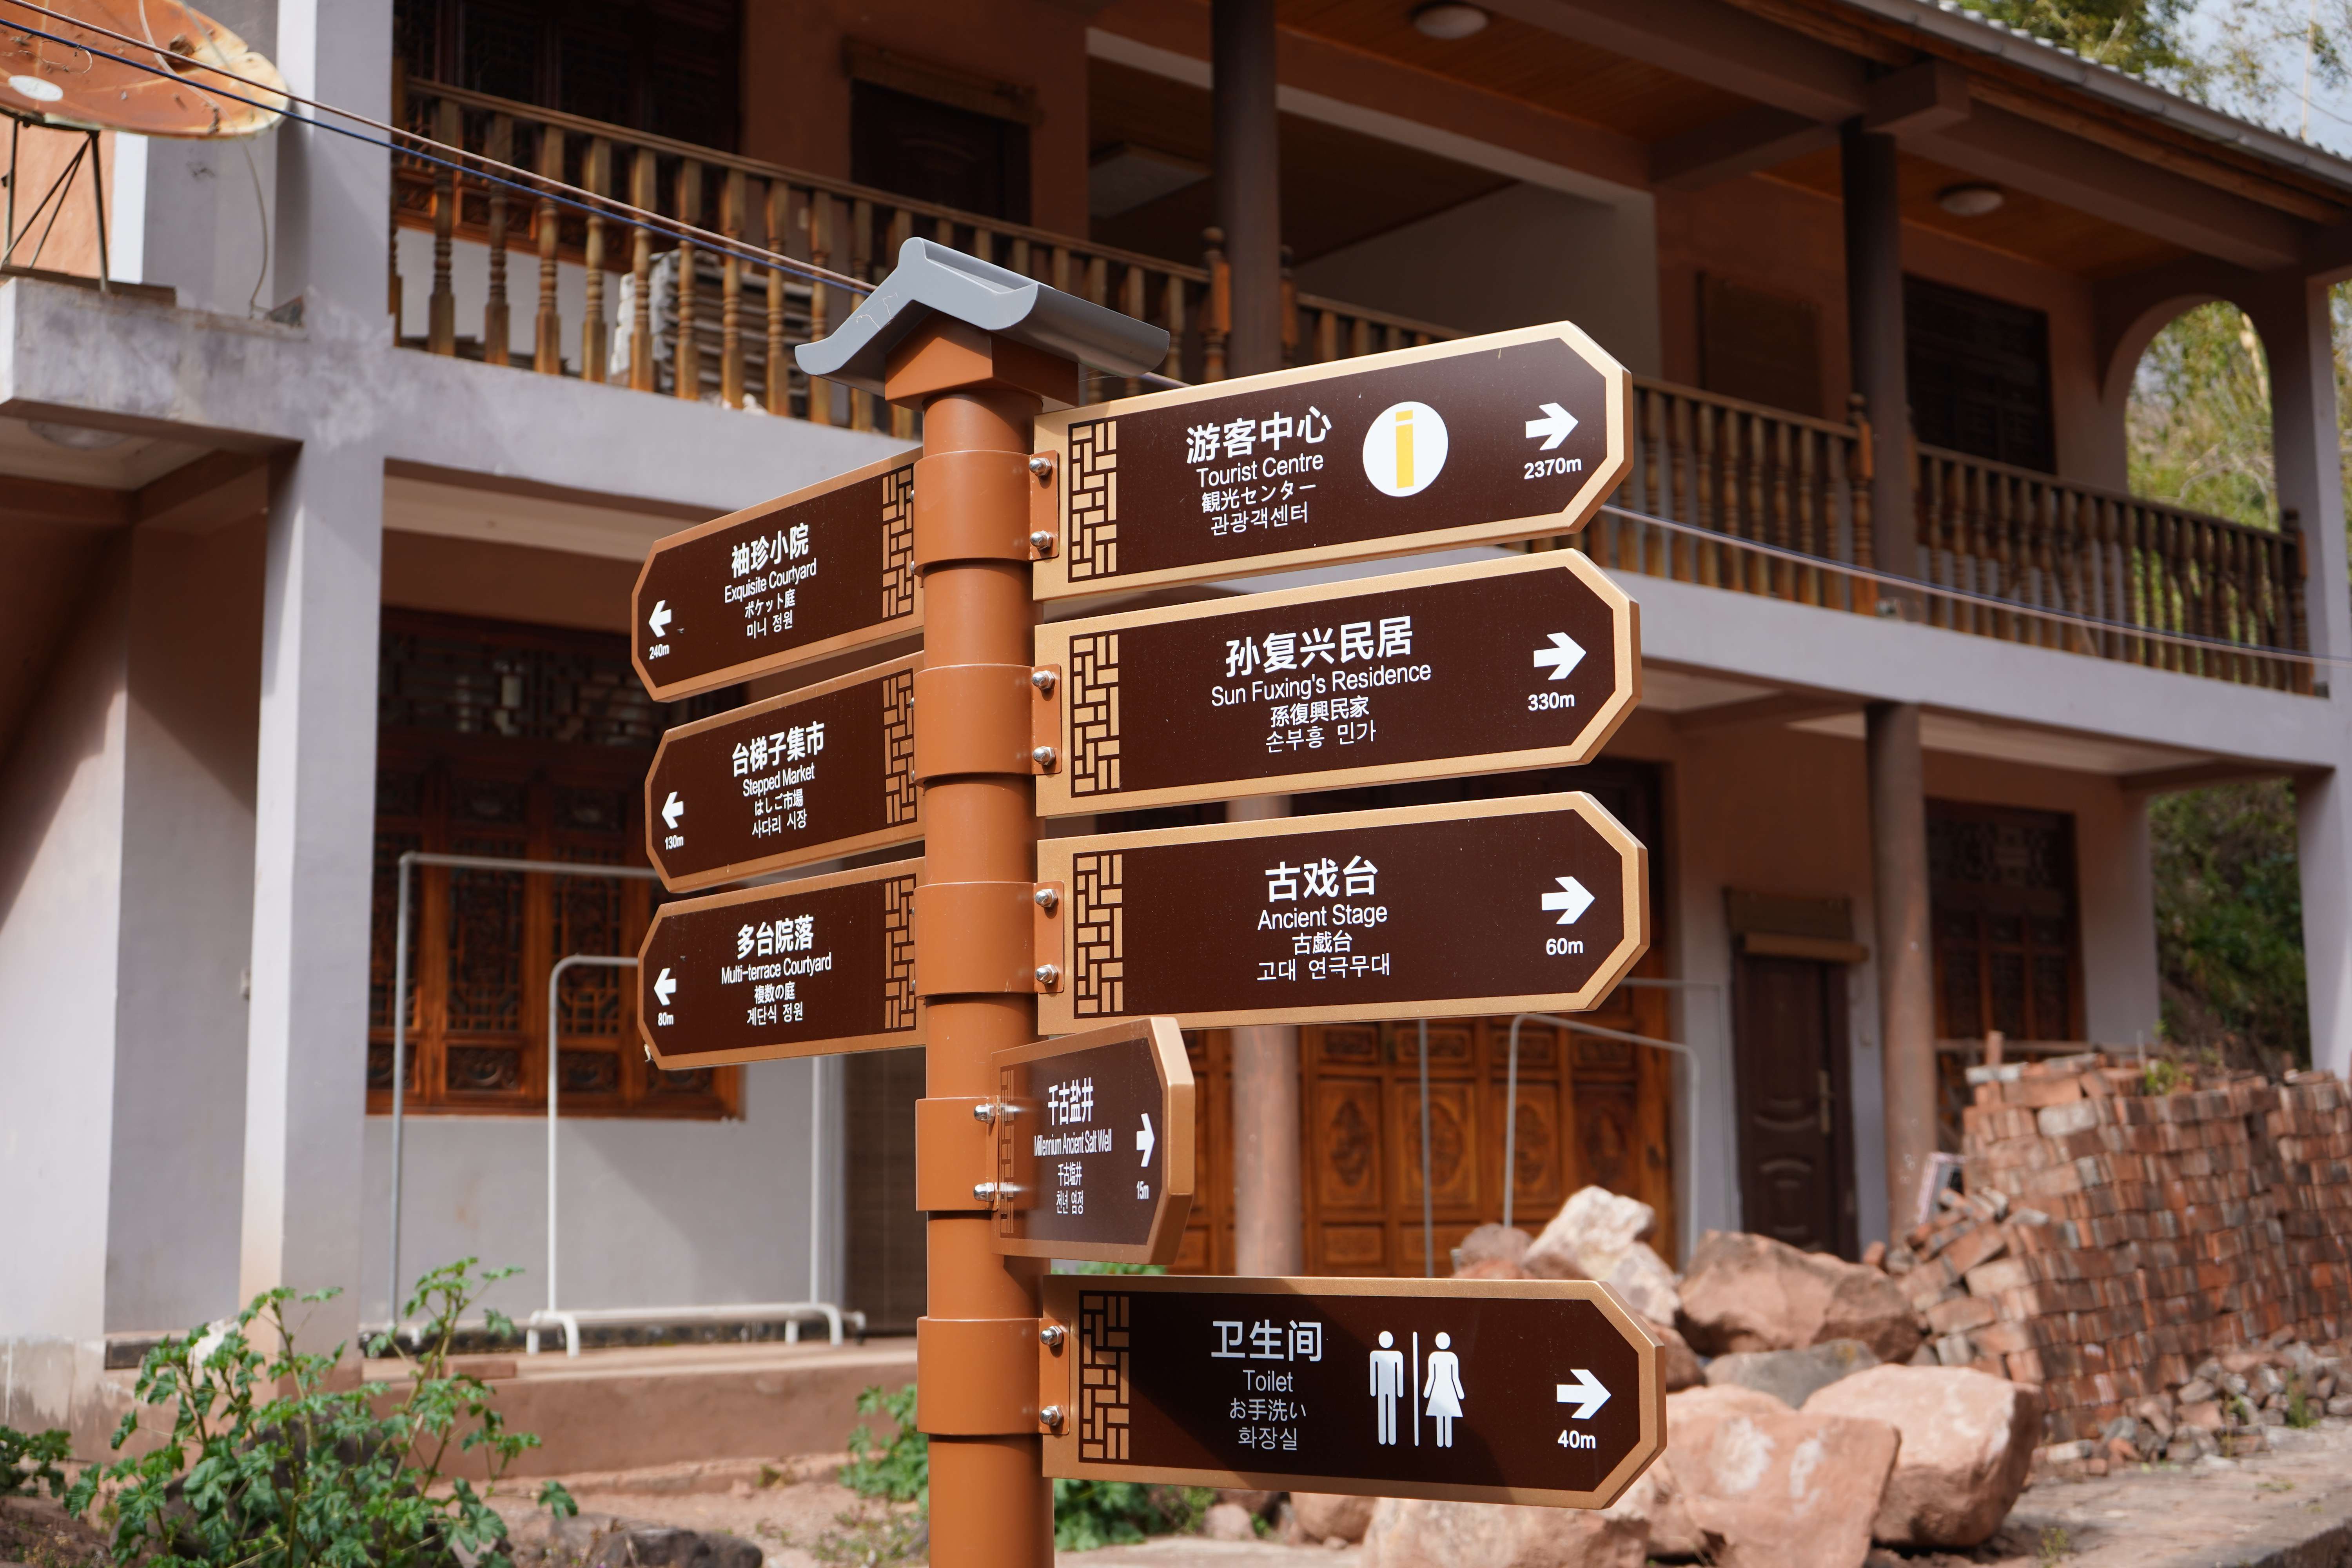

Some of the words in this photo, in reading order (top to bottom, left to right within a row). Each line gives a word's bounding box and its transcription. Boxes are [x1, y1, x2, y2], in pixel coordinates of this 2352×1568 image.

[1186, 406, 1332, 464] 游客中心
[1196, 460, 1258, 488] Tourist
[1262, 453, 1323, 477] Centre
[1524, 457, 1582, 479] 2370m
[1201, 481, 1316, 513] 観光センター
[1210, 501, 1307, 536] 관광객센터
[731, 522, 809, 578] 袖珍小院
[725, 576, 767, 603] Exquisite
[769, 557, 817, 589] Courtyard
[745, 588, 795, 619] ポケット庭
[747, 617, 766, 639] 미니
[772, 609, 793, 632] 정원
[649, 644, 670, 660] 240m
[1225, 615, 1413, 677] 孙复兴民居
[1212, 686, 1246, 706] Sun
[1252, 673, 1326, 702] Fuxing's
[1332, 664, 1431, 691] Residence
[1270, 695, 1369, 728] 孫復興民家
[1528, 692, 1575, 711] 330m
[732, 721, 824, 777] 台梯子集市
[1266, 726, 1325, 753] 손부흥
[1338, 719, 1377, 745] 민가
[743, 770, 780, 797] Stepped
[782, 762, 815, 786] Market
[755, 788, 804, 816] はしご市場
[752, 815, 781, 838] 사다리
[786, 808, 807, 830] 시장
[665, 835, 684, 850] 130m
[1265, 855, 1378, 902] 古戏台
[1257, 906, 1327, 930] Ancient
[1332, 904, 1387, 928] Stage
[737, 914, 814, 960] 多台院落
[1546, 938, 1583, 955] 60m
[721, 963, 781, 984] Multi-terrace
[783, 951, 831, 976] Courtyard
[1257, 958, 1296, 981] 고대
[1308, 953, 1390, 979] 연극무대
[754, 981, 795, 1004] 複数の庭
[658, 1012, 674, 1026] 80m
[747, 1004, 777, 1026] 계단식
[782, 1001, 803, 1022] 정원
[1048, 1077, 1094, 1126] 千古盐井
[1034, 1134, 1062, 1156] Millennium
[1062, 1132, 1084, 1154] Ancient
[1085, 1130, 1097, 1153] Salt
[1097, 1128, 1112, 1152] Well
[1056, 1190, 1068, 1214] 천년
[1071, 1190, 1083, 1214] 염정
[1136, 1181, 1149, 1200] 15m
[1211, 1319, 1321, 1361] 卫生间
[1243, 1370, 1293, 1392] Toilet
[1230, 1398, 1306, 1421] お手洗い
[1238, 1426, 1297, 1450] 화장실
[1557, 1430, 1596, 1449] 40m
